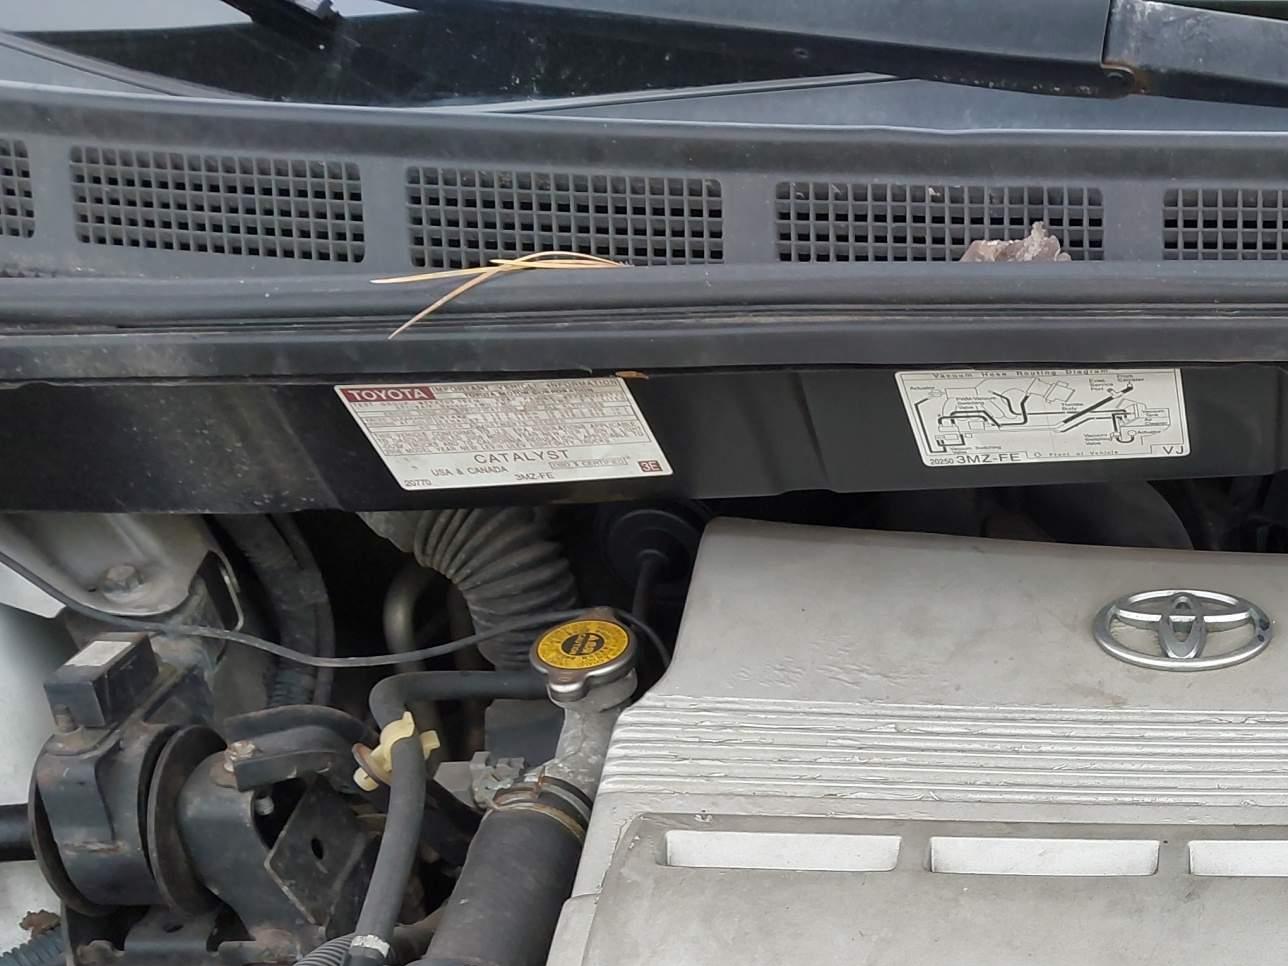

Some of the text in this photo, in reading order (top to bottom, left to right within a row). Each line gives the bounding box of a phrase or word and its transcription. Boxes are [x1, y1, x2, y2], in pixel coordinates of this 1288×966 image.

[348, 388, 429, 400] TOYOTA
[474, 450, 569, 464] CATALYST
[956, 453, 1020, 464] 3MZ-FE
[431, 468, 454, 476] USA
[467, 465, 509, 474] CANADA
[640, 461, 660, 472] 3E
